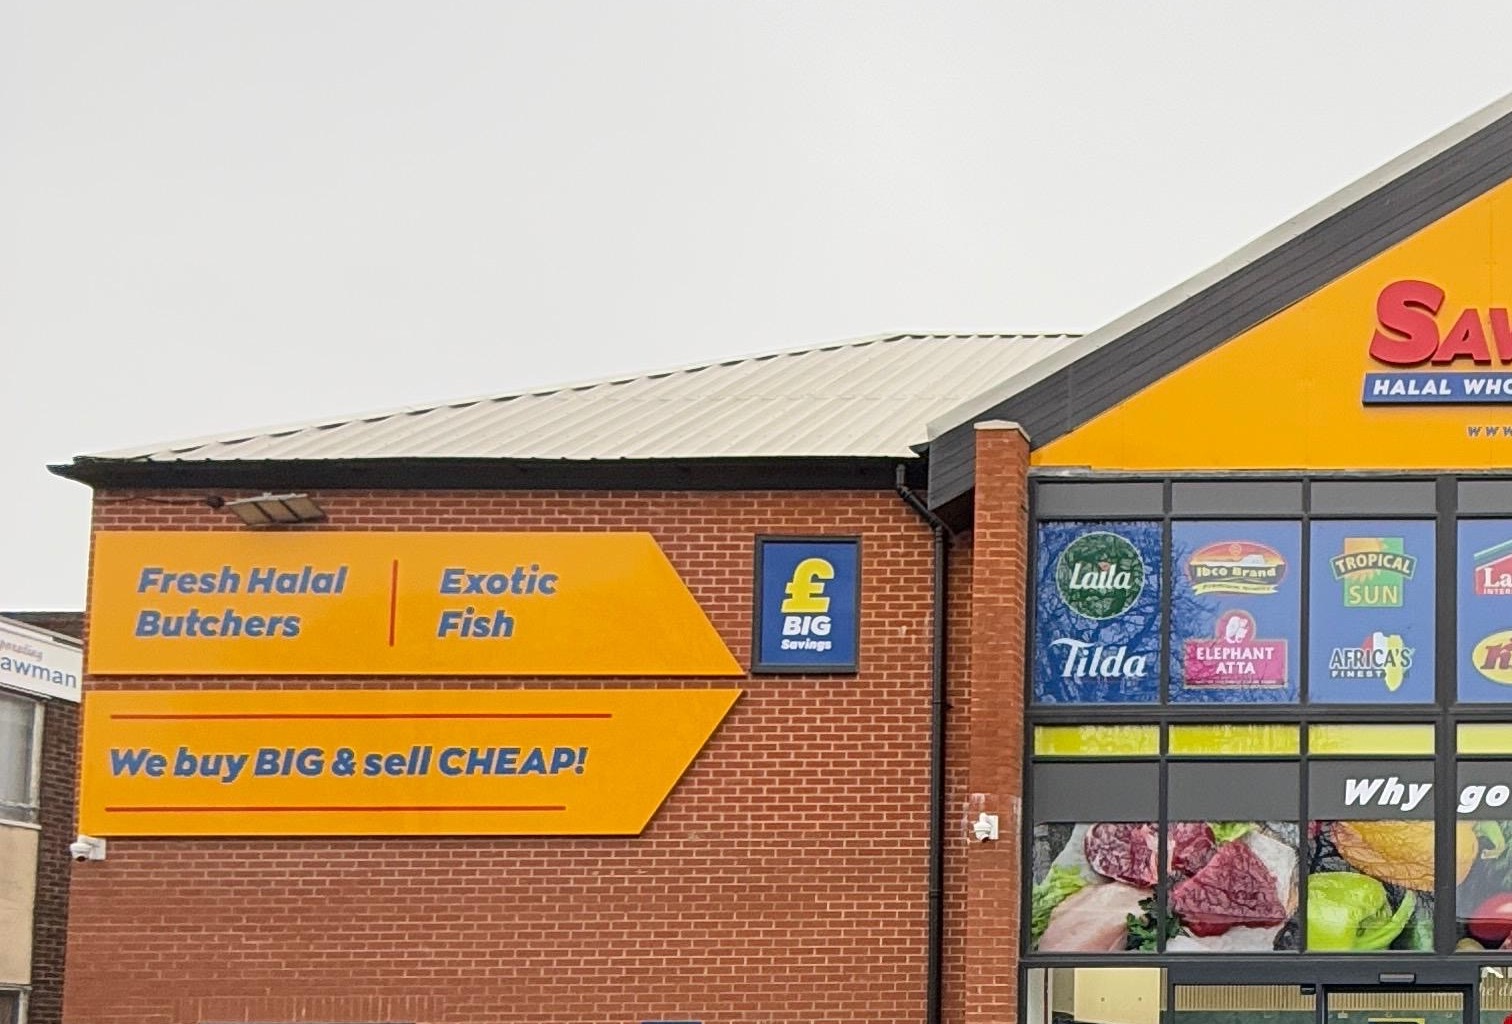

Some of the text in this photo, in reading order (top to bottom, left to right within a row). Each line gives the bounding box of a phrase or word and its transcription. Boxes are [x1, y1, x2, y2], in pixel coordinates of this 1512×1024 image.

[1372, 378, 1452, 396] HALAL
[1232, 565, 1277, 578] Brand
[1335, 553, 1411, 574] TROPICAL
[137, 566, 349, 594] Fresh Halal
[438, 564, 558, 595] Exotic
[1069, 562, 1132, 590] Laila
[1349, 585, 1398, 604] SUN
[135, 608, 301, 637] Butchers
[437, 607, 514, 637] Fish
[782, 615, 832, 636] BIG
[781, 638, 832, 652] Savings
[1196, 647, 1275, 660] ELEPHANT
[1051, 638, 1148, 677] Tilda
[1215, 661, 1256, 675] ATTA
[1330, 647, 1411, 669] AFRICA'S
[110, 746, 588, 783] We buy BIG & sell CHEAP!
[1344, 777, 1433, 811] Why
[1456, 784, 1510, 814] go
